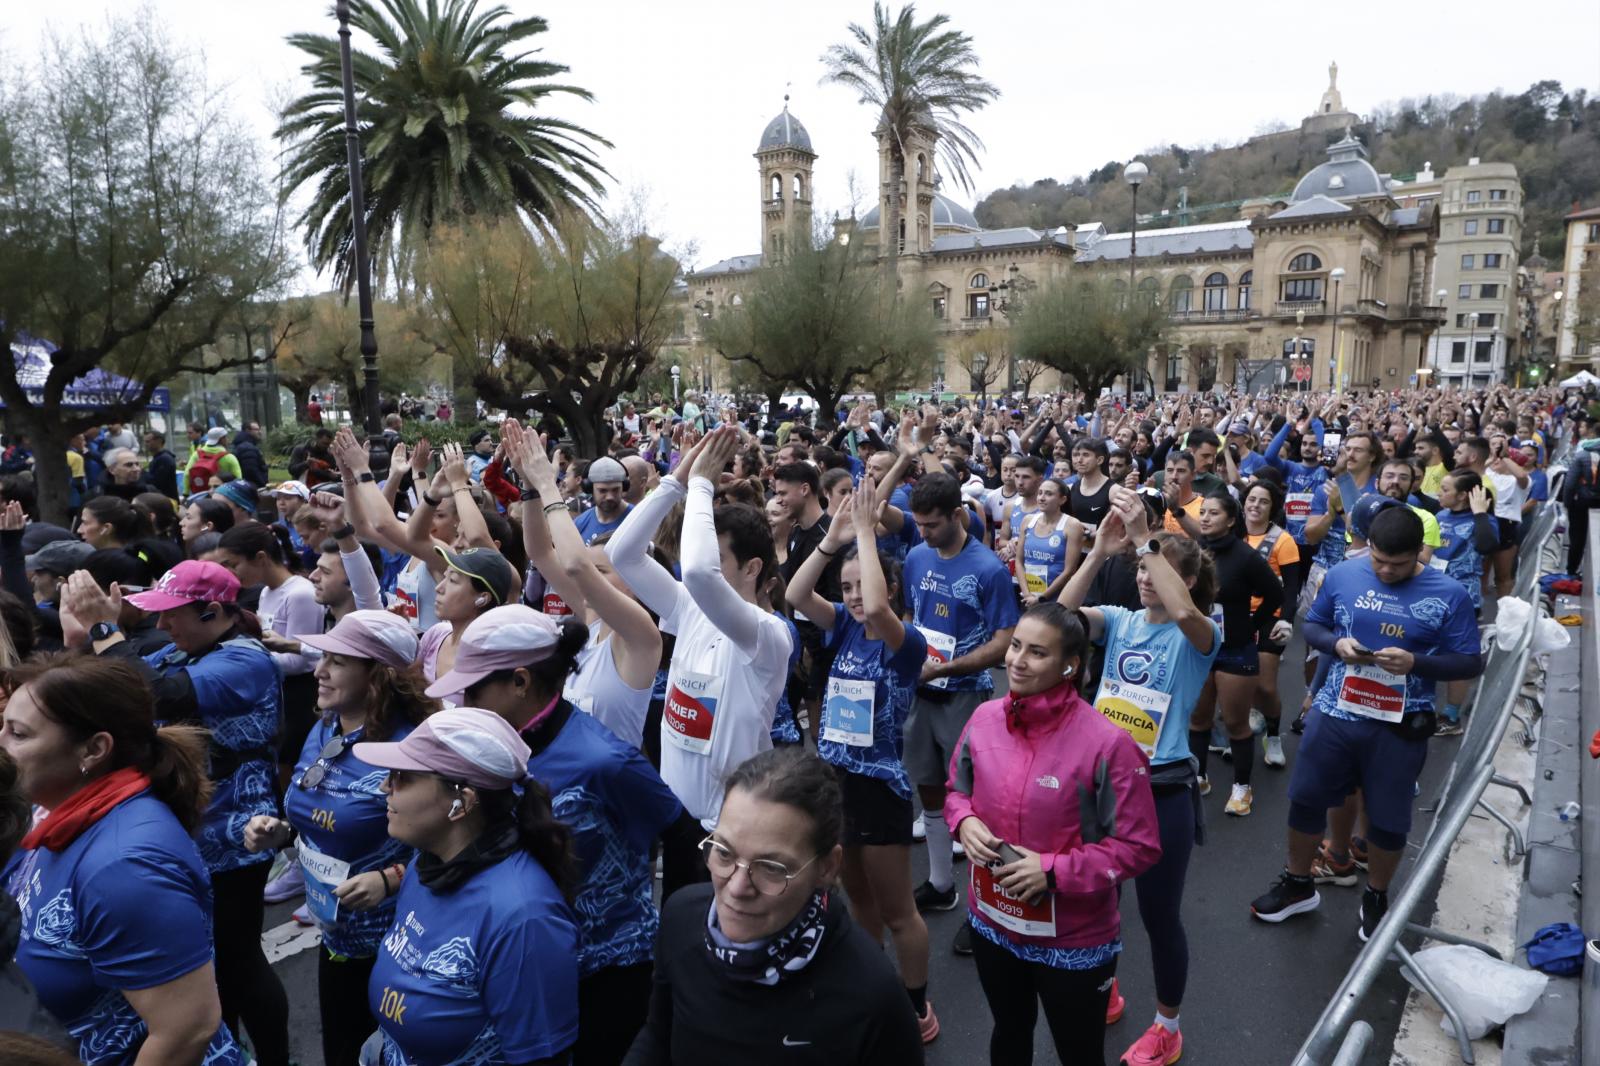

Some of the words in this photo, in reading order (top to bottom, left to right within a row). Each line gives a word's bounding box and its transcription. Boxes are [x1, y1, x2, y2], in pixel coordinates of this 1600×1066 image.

[1380, 622, 1406, 639] 10k
[1121, 688, 1154, 705] ZURICH
[669, 698, 698, 721] AXIER
[1103, 707, 1154, 732] PATRICIA
[311, 807, 337, 832] 10k
[996, 899, 1024, 918] 10919
[379, 985, 407, 1026] 10k
